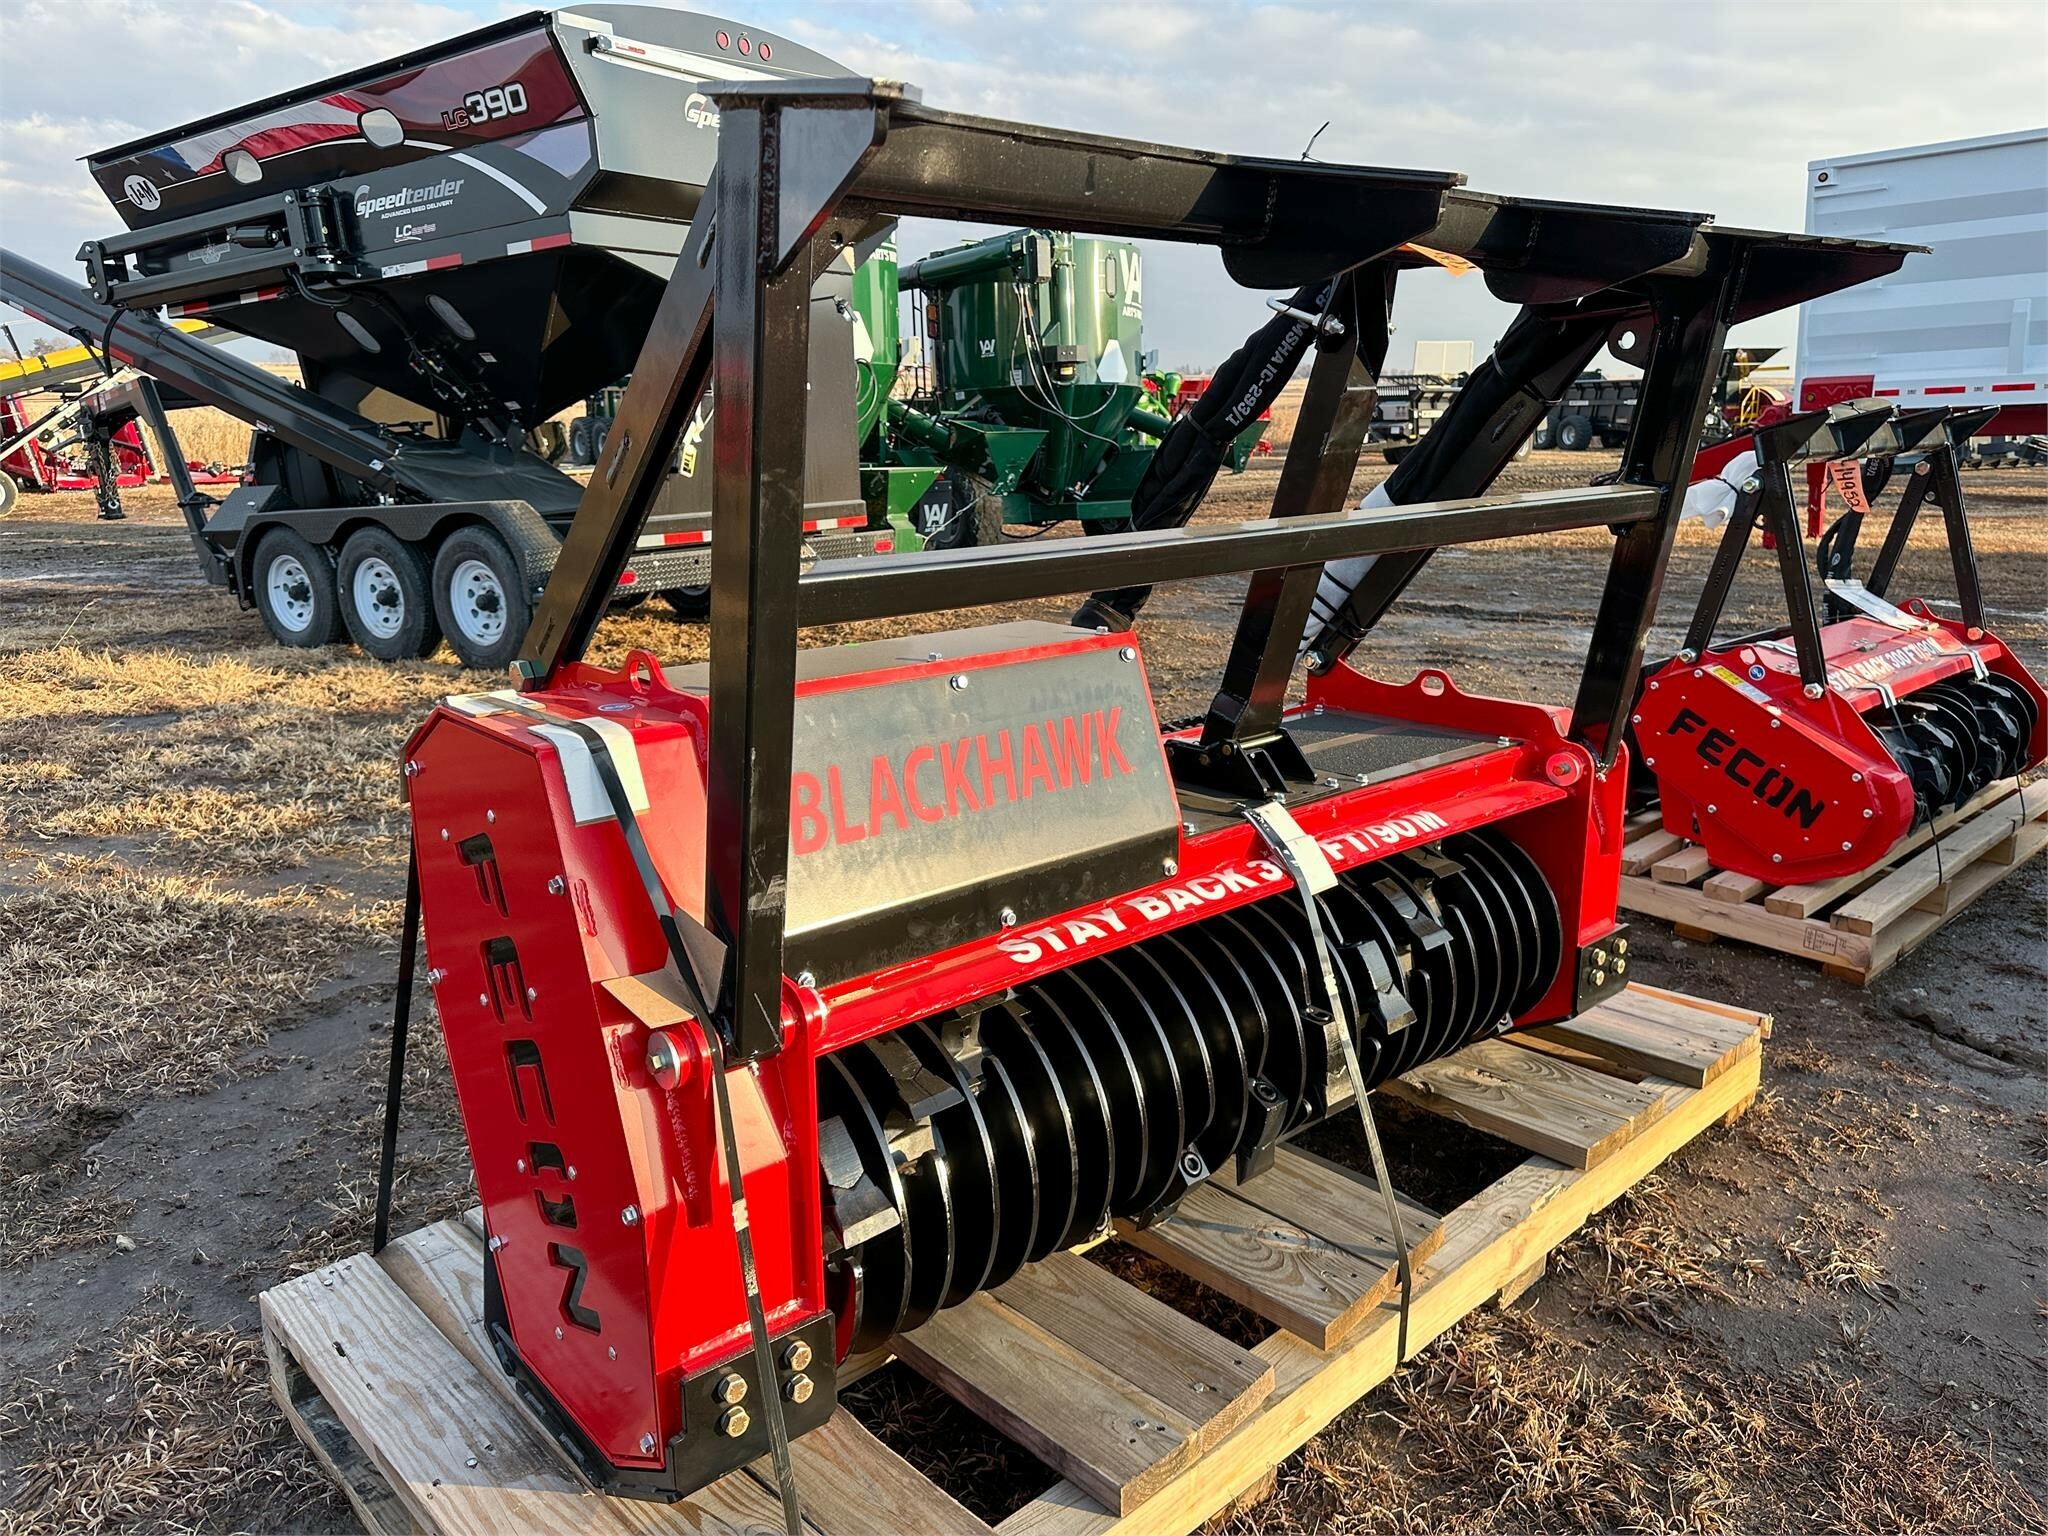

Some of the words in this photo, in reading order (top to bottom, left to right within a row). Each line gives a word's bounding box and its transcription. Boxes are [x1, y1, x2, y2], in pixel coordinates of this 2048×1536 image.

[128, 180, 159, 206] J&M
[381, 208, 411, 219] ADVANCED
[426, 199, 454, 210] DELIVERY
[1826, 666, 1862, 691] STAY
[1854, 655, 1896, 680] BACK
[790, 706, 1134, 857] BLACKHAWK
[1666, 707, 1825, 829] FECON
[997, 908, 1128, 964] STAY
[1126, 863, 1258, 921] BACK
[455, 832, 601, 1335] FECON
